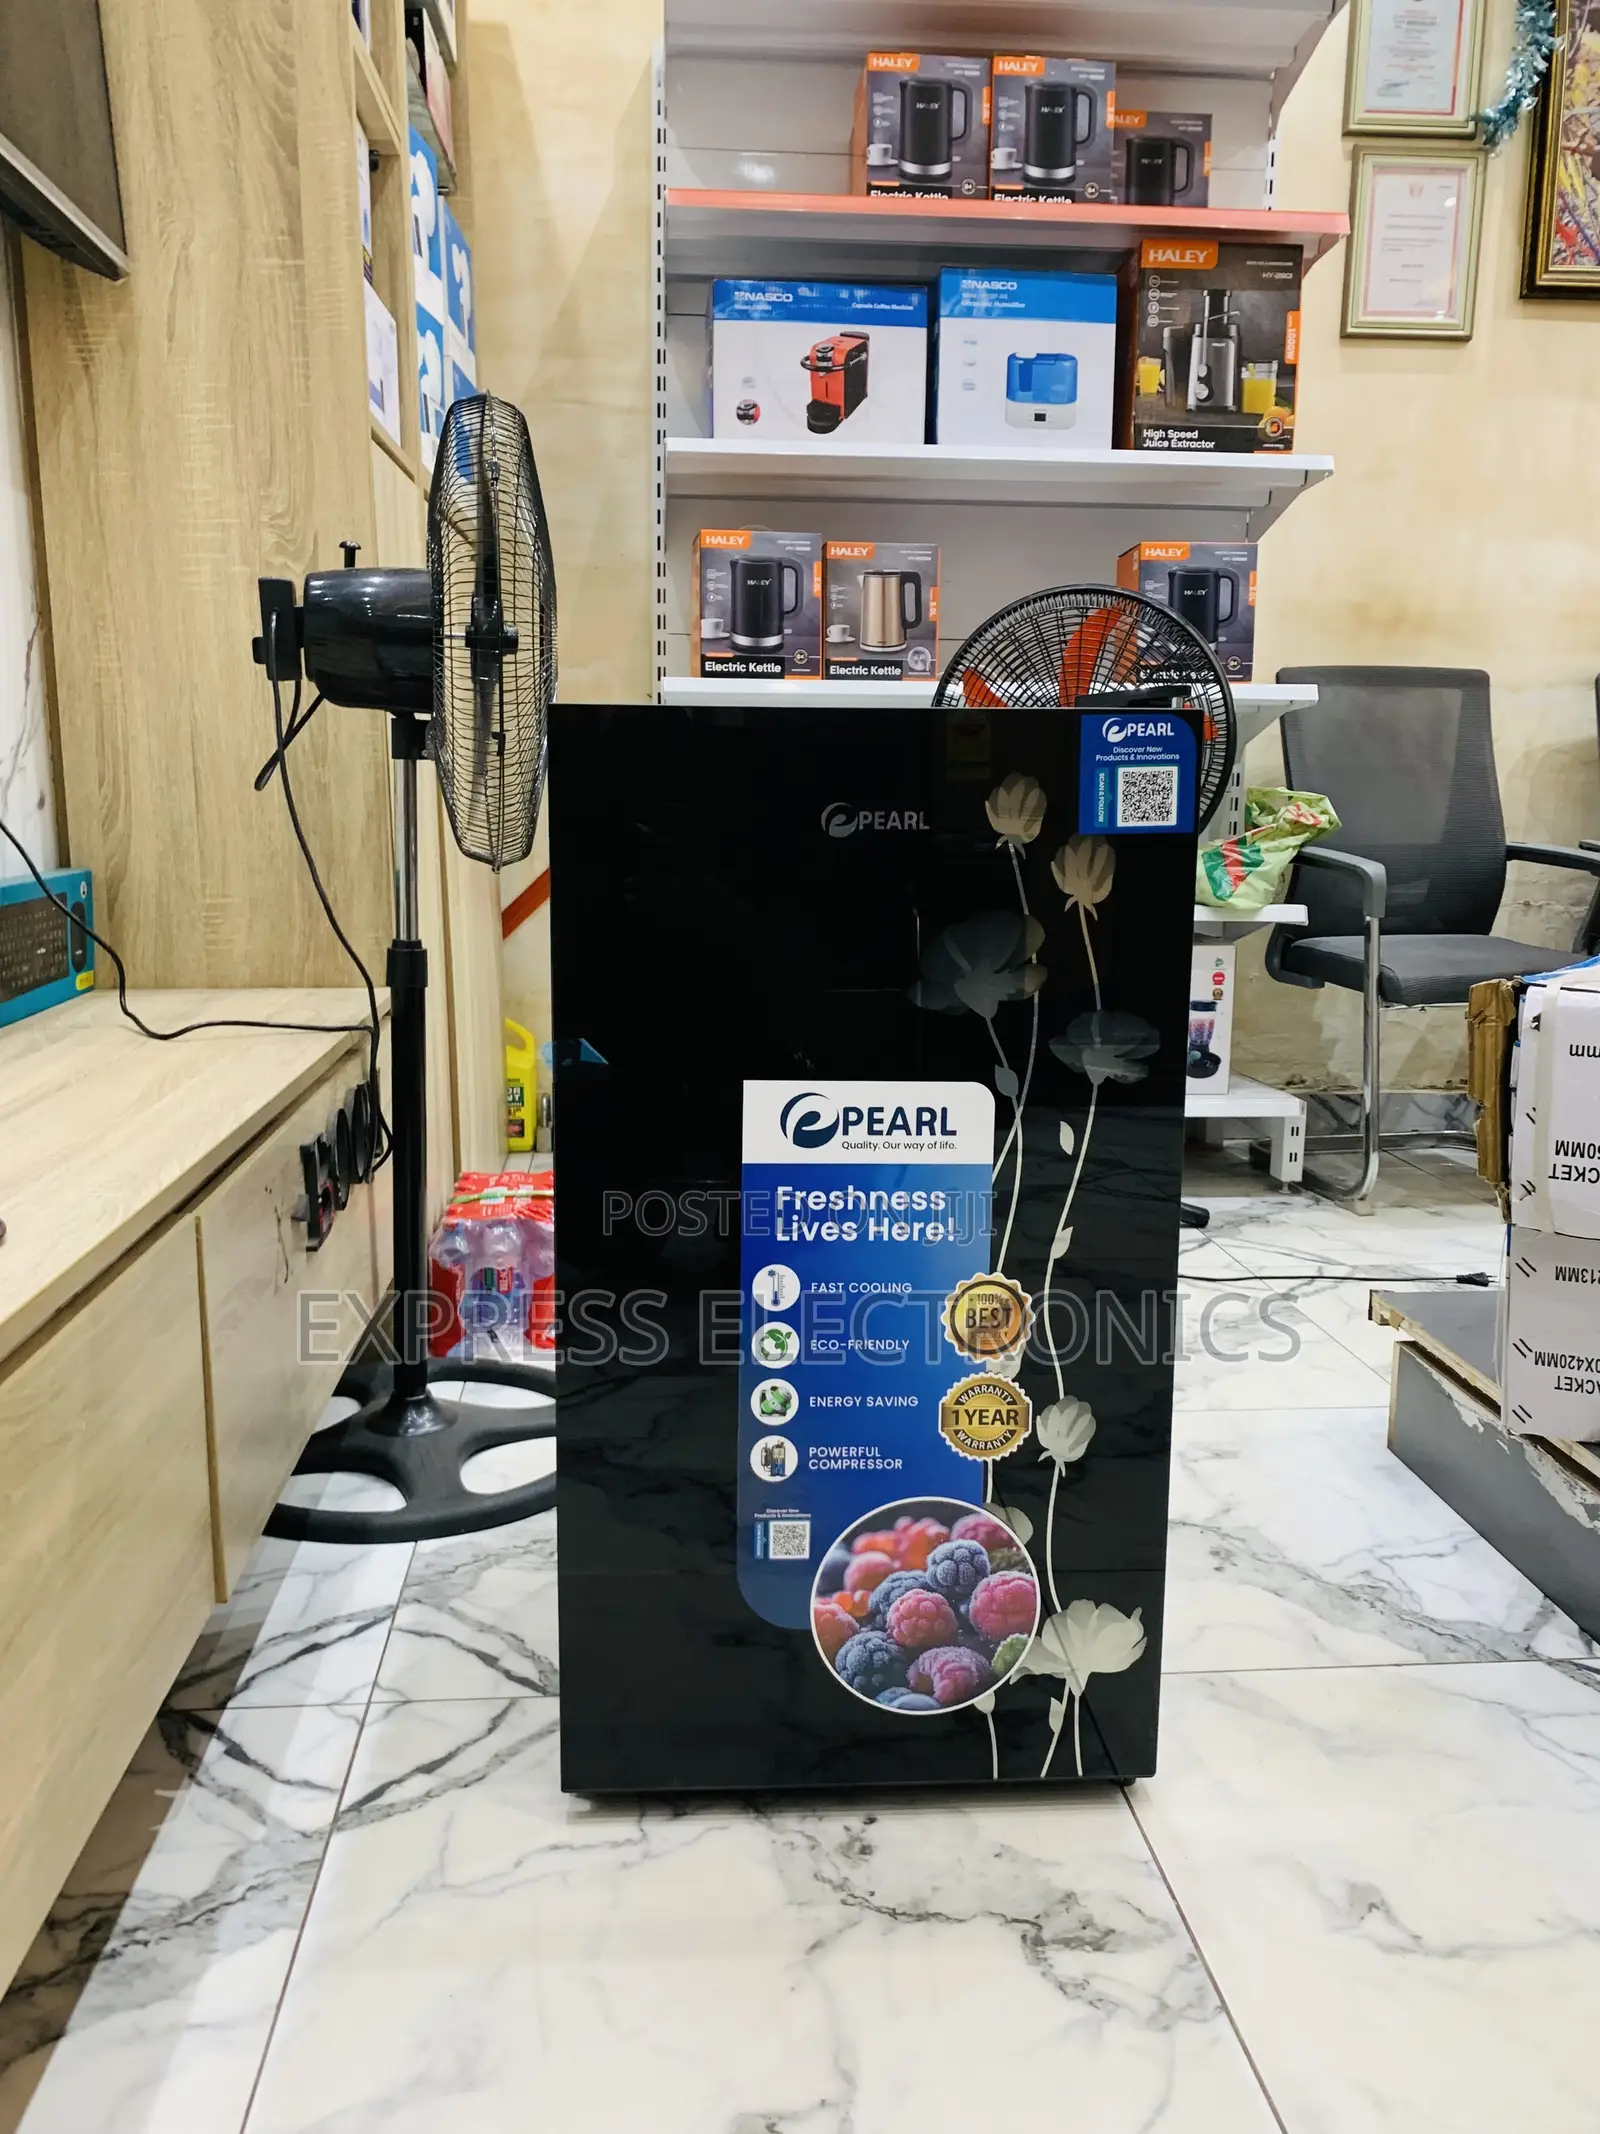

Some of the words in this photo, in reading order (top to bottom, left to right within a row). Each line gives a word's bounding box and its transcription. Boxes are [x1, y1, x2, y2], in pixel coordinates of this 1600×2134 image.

[872, 56, 913, 68] HALEY
[998, 60, 1039, 72] HALEY
[1114, 115, 1140, 124] ALEY
[1149, 249, 1208, 263] HALEY
[972, 280, 1018, 290] NASCO
[745, 292, 793, 302] NASCO
[1144, 429, 1166, 439] High
[1168, 430, 1198, 440] Speed
[1143, 439, 1170, 448] Juice
[1171, 440, 1216, 449] Extractor
[706, 536, 744, 546] HALEY
[831, 547, 868, 556] HALEY
[1145, 548, 1183, 556] HALEY
[705, 662, 746, 673] Electric
[748, 662, 782, 673] Kettle
[830, 666, 868, 675] Electric
[870, 666, 902, 676] Kettle
[1127, 722, 1175, 737] PEARL
[1096, 754, 1128, 762] Products
[858, 810, 930, 830] PEARL
[842, 1106, 958, 1136] PEARL
[842, 1140, 880, 1152] Quality.
[882, 1140, 901, 1150] Our
[902, 1143, 924, 1152] way
[926, 1140, 938, 1150] of
[939, 1140, 958, 1150] life.
[776, 1185, 946, 1210] Freshness
[776, 1214, 858, 1242] Lives
[868, 1216, 955, 1242] Here!
[1556, 1266, 1600, 1285] 13MM
[811, 1282, 844, 1294] FAST
[848, 1282, 912, 1294] COOLING
[966, 1308, 1011, 1328] BEST
[810, 1339, 910, 1351] ECO-FRIENDLY
[958, 1384, 1014, 1405] WARRANTY
[810, 1396, 861, 1408] ENERGY
[866, 1396, 918, 1408] SAVING
[951, 1409, 960, 1426] 1
[965, 1408, 1019, 1426] YEAR
[956, 1430, 1014, 1450] WARRANTY
[809, 1446, 880, 1458] POWERFUL
[809, 1458, 902, 1470] COMPRESSOR
